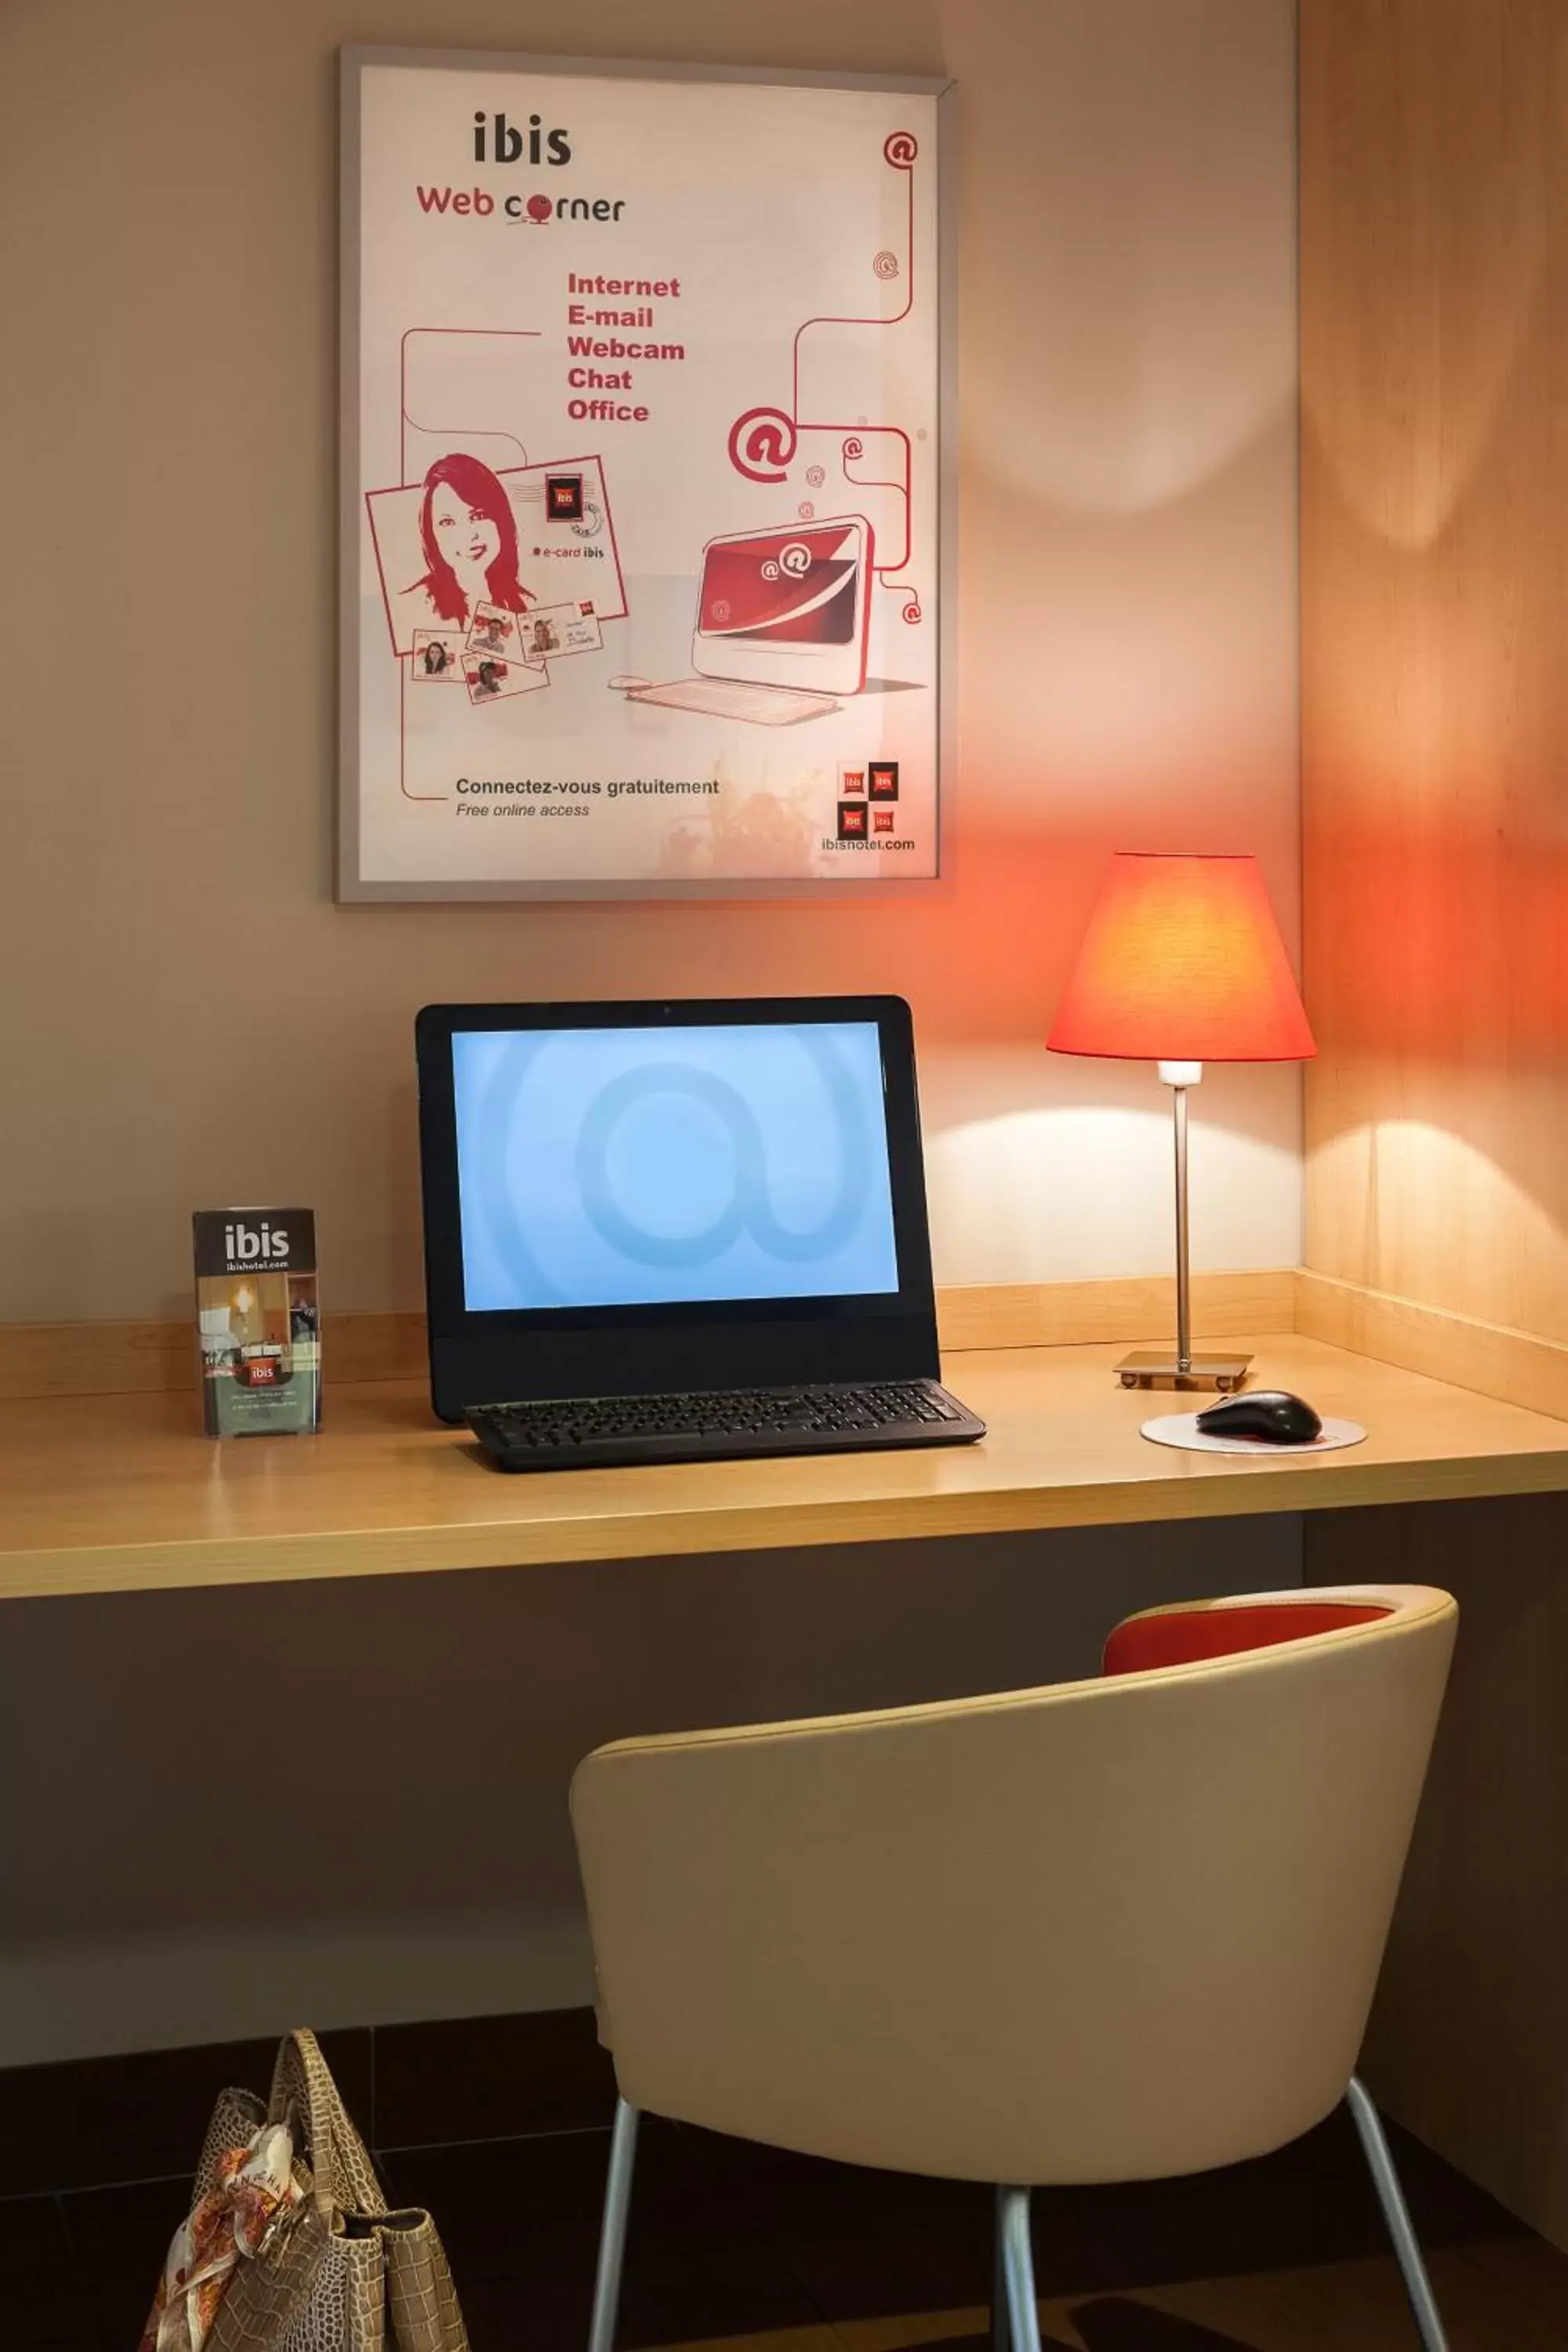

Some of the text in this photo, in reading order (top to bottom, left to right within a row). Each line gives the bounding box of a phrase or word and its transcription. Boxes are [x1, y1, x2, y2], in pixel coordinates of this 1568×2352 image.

[474, 111, 572, 166] ibis
[416, 186, 494, 216] Web
[568, 273, 681, 297] Internet
[568, 305, 652, 328] E-mail
[568, 336, 684, 360] Webcam
[568, 368, 632, 390] Chat
[568, 399, 649, 421] Office
[543, 546, 604, 558] e-card ibis
[456, 779, 720, 798] Connectez-vous gratuitement
[456, 803, 590, 817] Free online access
[225, 1222, 289, 1260] ibis
[226, 1261, 289, 1272] ibishotel.com
[252, 1367, 274, 1379] ibis
